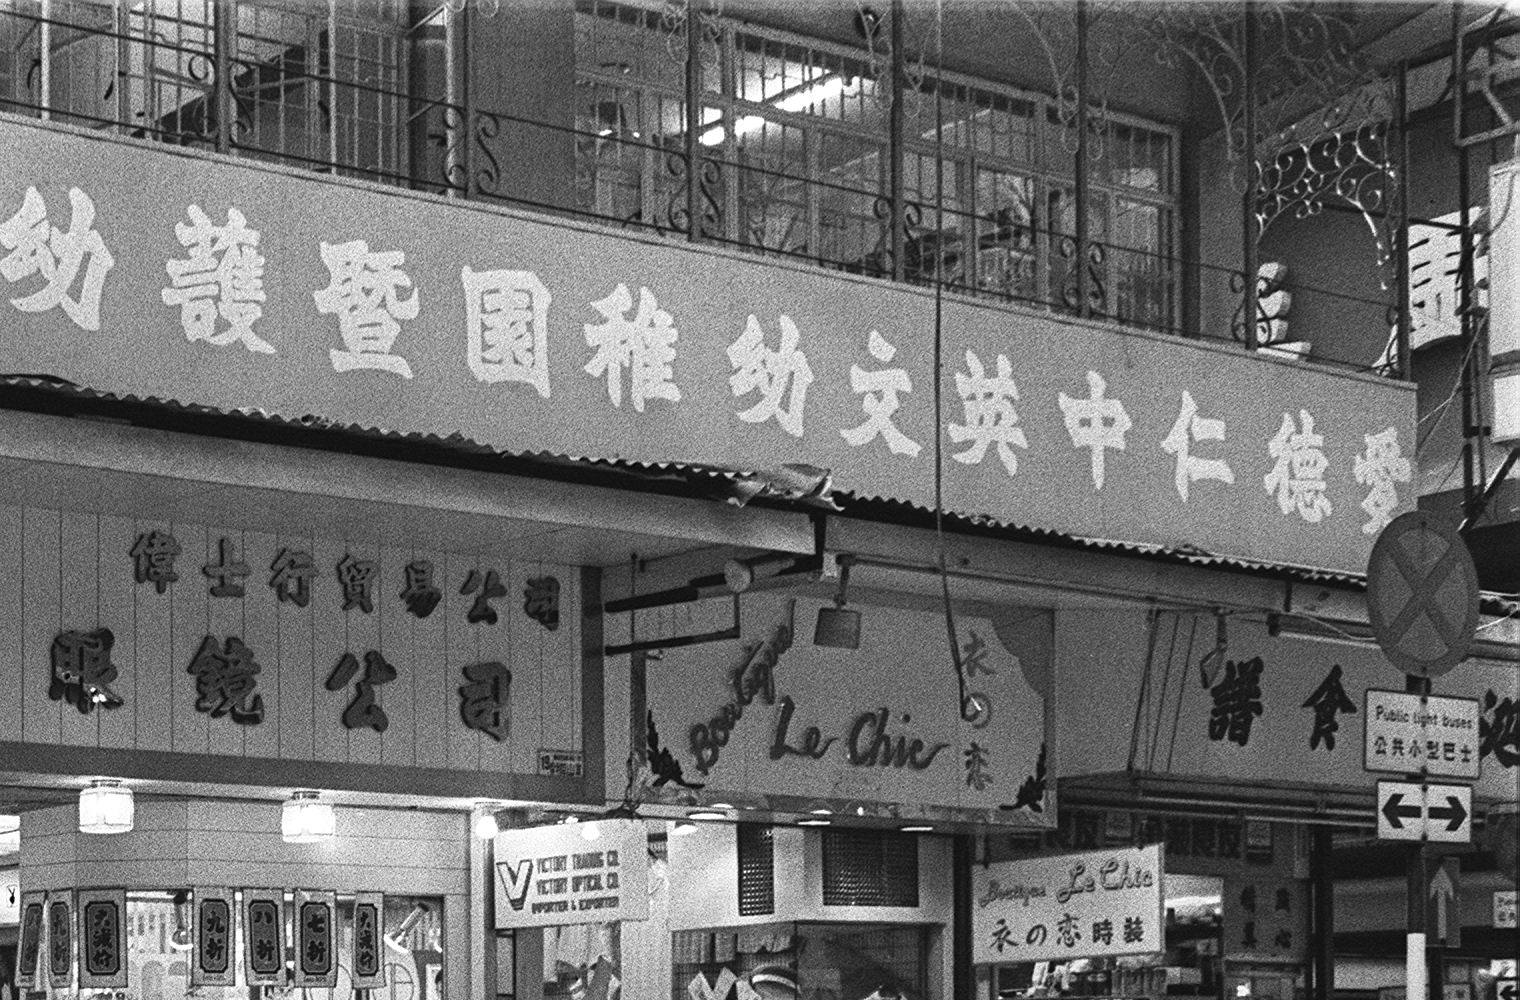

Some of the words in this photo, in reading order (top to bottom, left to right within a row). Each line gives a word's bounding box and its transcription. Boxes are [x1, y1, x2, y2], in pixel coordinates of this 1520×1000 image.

[769, 694, 837, 761] Le
[846, 708, 951, 770] Chic
[1375, 705, 1409, 723] Public
[1413, 711, 1439, 728] light
[1442, 716, 1473, 729] buses
[1374, 736, 1473, 763] 公共小型巴士
[495, 858, 534, 911] V
[1056, 860, 1096, 904] Le
[1099, 857, 1153, 891] Chic
